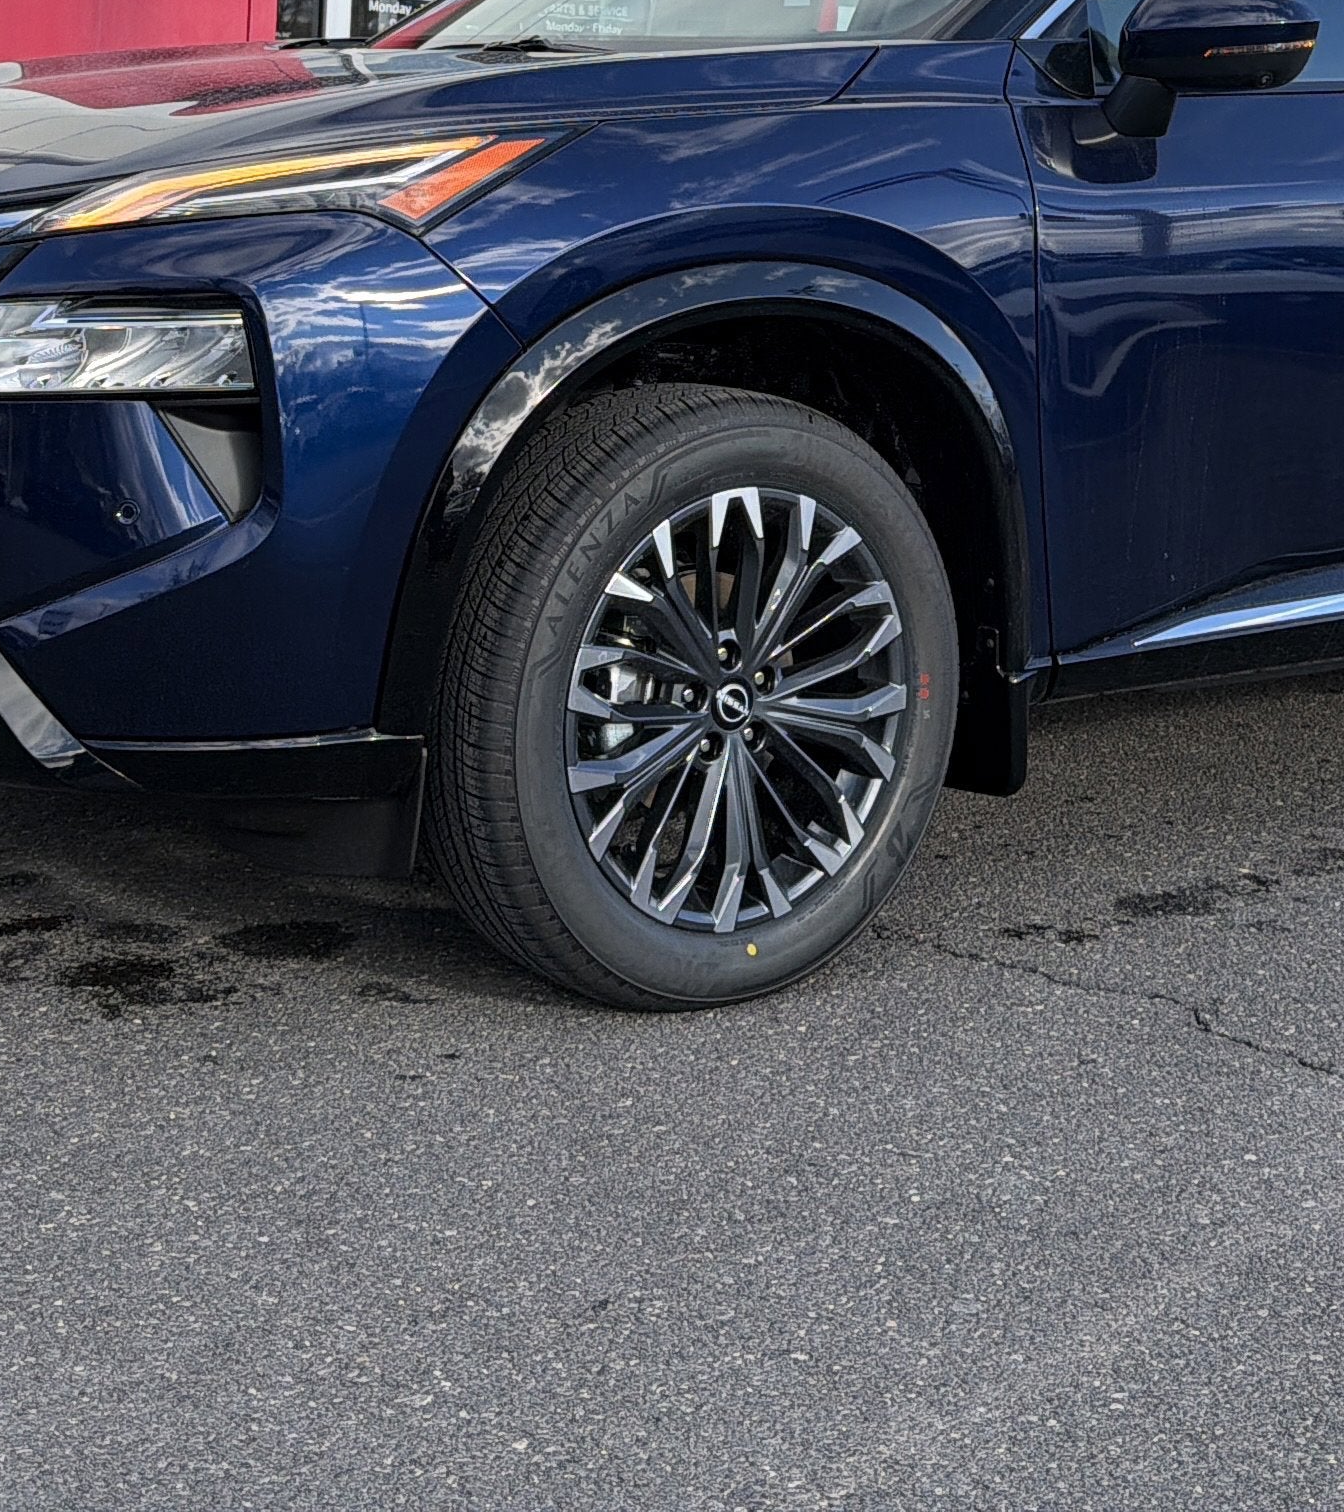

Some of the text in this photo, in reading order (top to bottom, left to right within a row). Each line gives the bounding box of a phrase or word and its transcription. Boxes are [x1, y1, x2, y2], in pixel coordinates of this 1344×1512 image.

[368, 0, 413, 17] Monday
[545, 19, 585, 33] Monday
[545, 491, 641, 637] ALENZA
